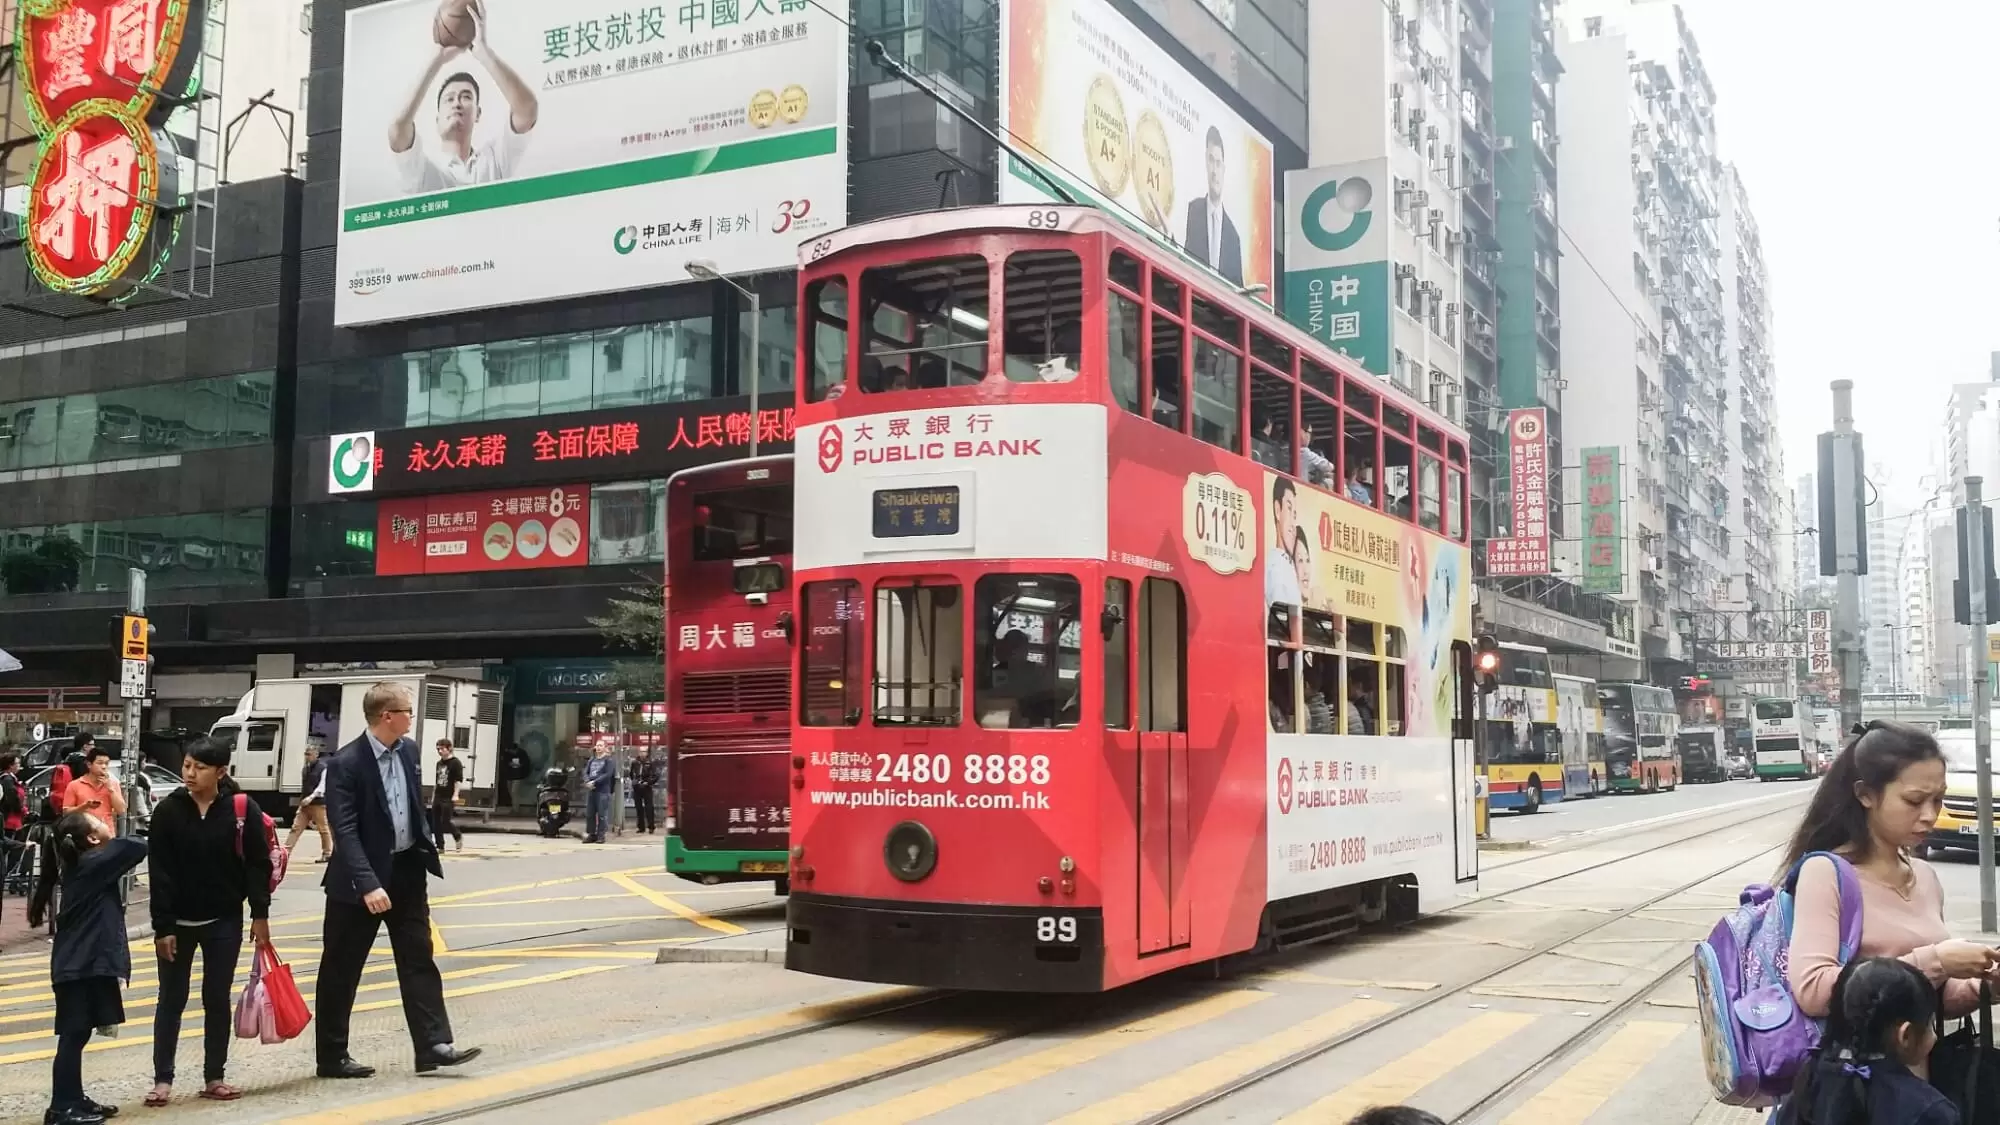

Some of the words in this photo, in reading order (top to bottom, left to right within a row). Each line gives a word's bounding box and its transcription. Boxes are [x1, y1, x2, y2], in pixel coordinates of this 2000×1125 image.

[542, 6, 667, 64] 要投就投
[1093, 103, 1124, 133] STANDARD
[1100, 138, 1116, 163] A+
[1146, 167, 1160, 192] A1
[36, 130, 137, 261] 押
[642, 218, 703, 240] 中国人寿
[716, 212, 751, 236] 海外
[1027, 210, 1060, 229] 89
[642, 237, 676, 250] CHINA
[678, 234, 703, 246] LIFE
[810, 238, 832, 261] 89
[348, 277, 365, 290] 399
[365, 274, 392, 288] 95519
[397, 259, 496, 283] www.chinalife.com.hk
[1308, 279, 1324, 335] CHINA
[853, 412, 994, 444] 大眾銀行
[406, 434, 507, 473] 永久承諾
[532, 421, 640, 461] 全面保障
[853, 441, 945, 466] PUBLIC
[953, 438, 1042, 458] BANK
[1195, 501, 1246, 550] 0.11%
[678, 621, 756, 652] 周大福
[812, 626, 843, 636] FOOK
[875, 753, 951, 783] 2480
[963, 754, 1051, 785] 8888
[1297, 760, 1353, 782] 大眾銀行
[810, 789, 1051, 809] www.publicbank.com.hk
[1297, 789, 1337, 809] PUBLIC
[1339, 787, 1369, 806] BANK
[1309, 840, 1337, 871] 2480
[1340, 836, 1366, 866] 8888
[1036, 916, 1078, 942] 89
